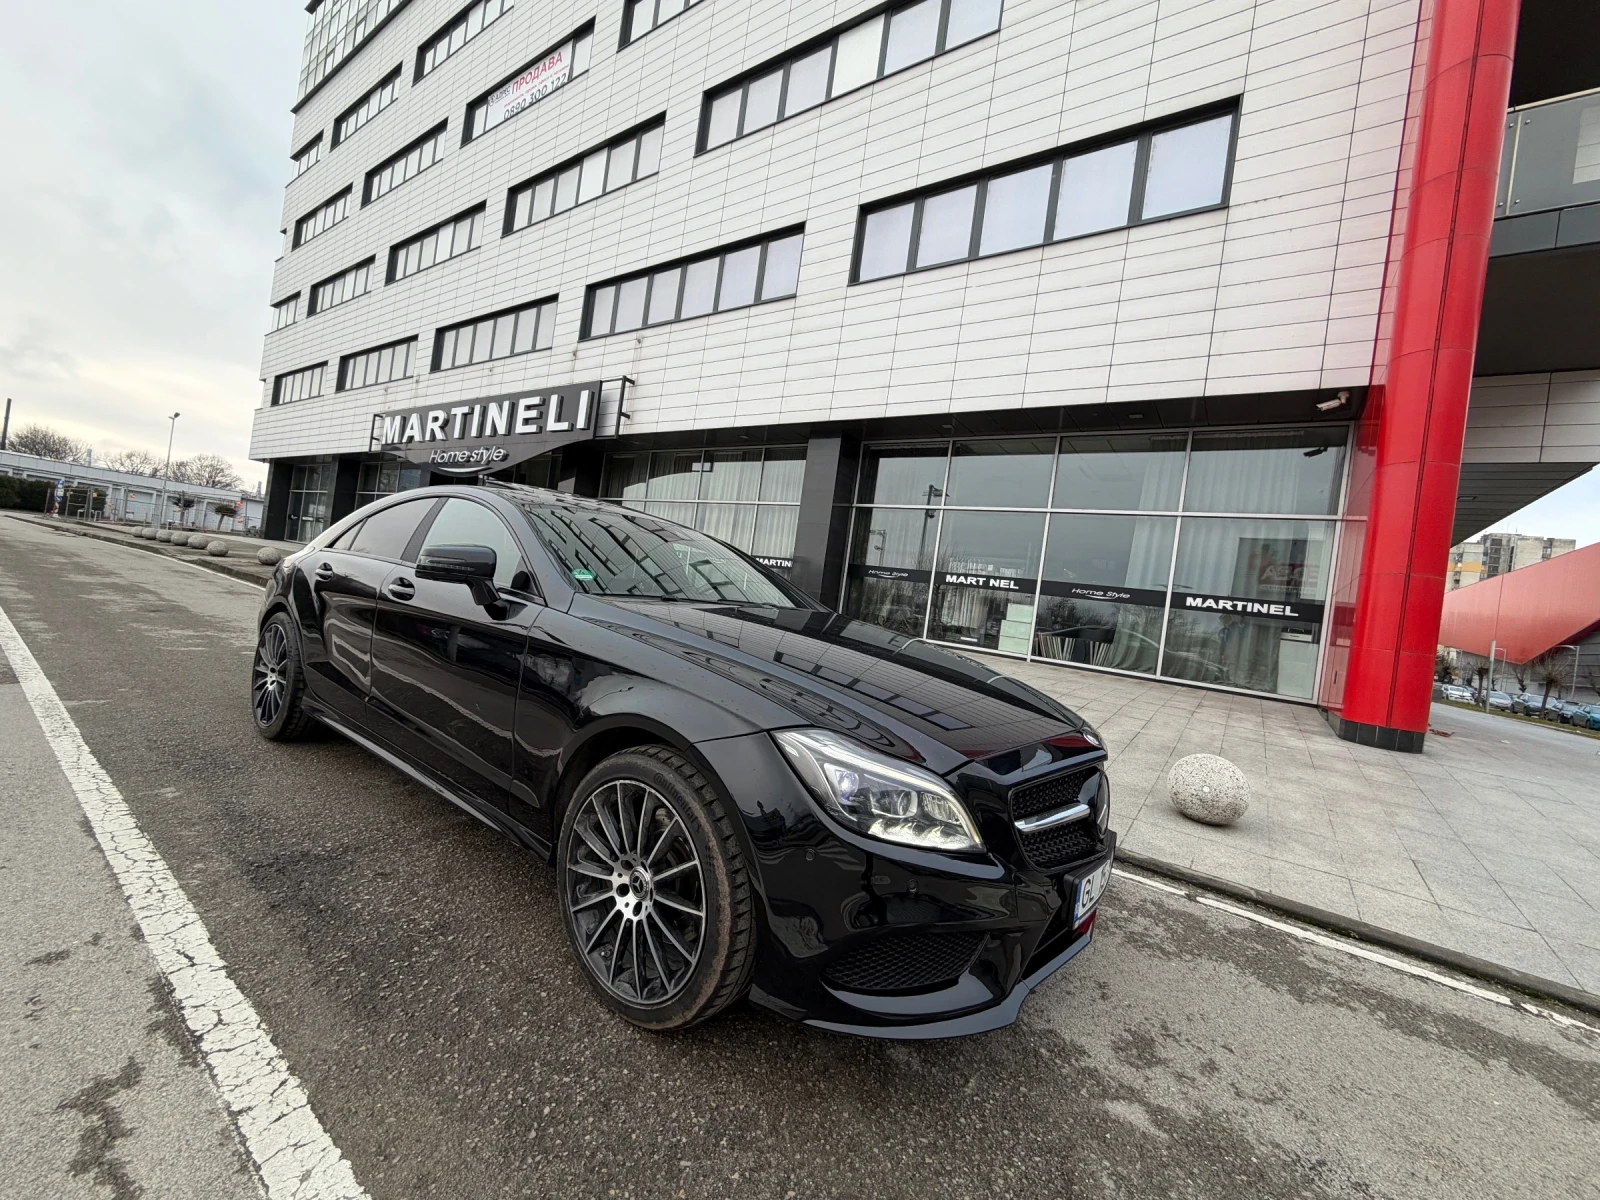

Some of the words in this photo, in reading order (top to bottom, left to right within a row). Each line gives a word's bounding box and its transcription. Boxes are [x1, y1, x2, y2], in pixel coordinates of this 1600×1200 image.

[511, 51, 563, 94] ПРОДАВА
[503, 98, 527, 120] 0890
[528, 85, 548, 105] 300
[550, 72, 567, 93] 122
[382, 389, 594, 445] MARTINELI
[428, 448, 467, 464] Home
[469, 445, 505, 464] style
[755, 557, 793, 568] MARTIN
[1071, 587, 1104, 597] Home
[1106, 590, 1131, 599] Style
[1186, 596, 1299, 617] MARTINEL
